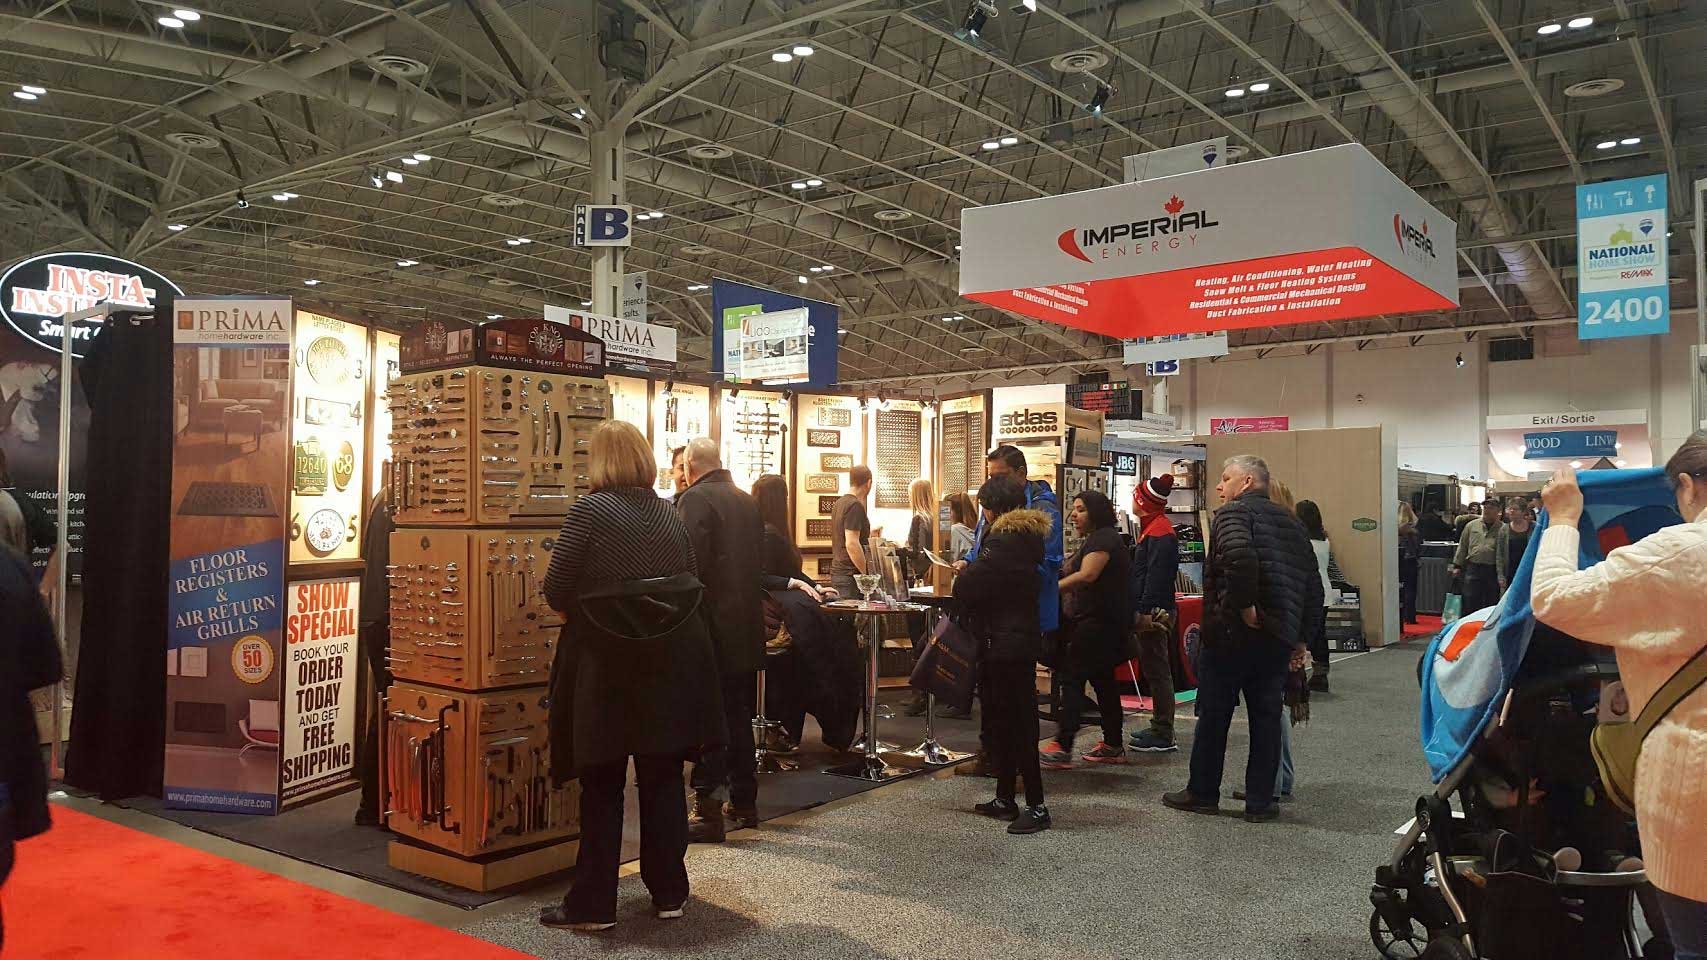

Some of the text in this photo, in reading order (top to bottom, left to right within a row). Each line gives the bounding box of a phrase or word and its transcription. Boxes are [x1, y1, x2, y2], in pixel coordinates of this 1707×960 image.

[577, 206, 585, 245] HALL
[591, 208, 628, 240] B
[1084, 211, 1218, 247] IMPERIAL
[1102, 234, 1198, 259] ENERGY
[1589, 243, 1655, 260] NATIONAL
[1231, 274, 1244, 283] Air
[1307, 264, 1333, 274] Water
[1336, 258, 1372, 270] Heating
[1589, 254, 1655, 269] HOME SHOW
[1621, 268, 1653, 279] RE/MAX
[1189, 298, 1233, 309] Residential
[1240, 292, 1287, 304] Commercial
[1288, 287, 1335, 298] Mechanical
[1336, 283, 1366, 293] Design
[1204, 288, 1226, 297] Snow
[1228, 285, 1247, 293] Melt
[1257, 281, 1278, 290] Floor
[1281, 277, 1315, 288] Heating
[1318, 272, 1356, 284] Systems
[1207, 310, 1226, 319] Duct
[1228, 305, 1277, 316] Fabrication
[1288, 297, 1341, 310] Installation
[1584, 296, 1663, 325] 2400
[491, 354, 516, 362] ALWAYS
[536, 359, 563, 368] PERFECT
[351, 400, 362, 426] 4
[1000, 408, 1057, 426] atlas
[297, 456, 327, 475] 12640
[335, 454, 353, 475] 68
[1115, 455, 1135, 470] JBG
[190, 549, 249, 574] FLOOR
[175, 561, 269, 594] REGISTERS
[215, 587, 229, 603] &
[297, 581, 350, 614] SHOW
[175, 594, 277, 629] AIR RETURN
[197, 615, 259, 640] GRILLS
[287, 608, 356, 645] SPECIAL
[242, 643, 260, 651] OVER
[242, 650, 262, 668] 50
[293, 642, 349, 662] BOOK YOUR
[244, 666, 263, 674] SIZES
[298, 655, 343, 687] ORDER
[296, 682, 341, 715] TODAY
[298, 707, 340, 728] AND GET
[303, 721, 335, 752] FREE
[283, 742, 351, 784] SHIPPING
